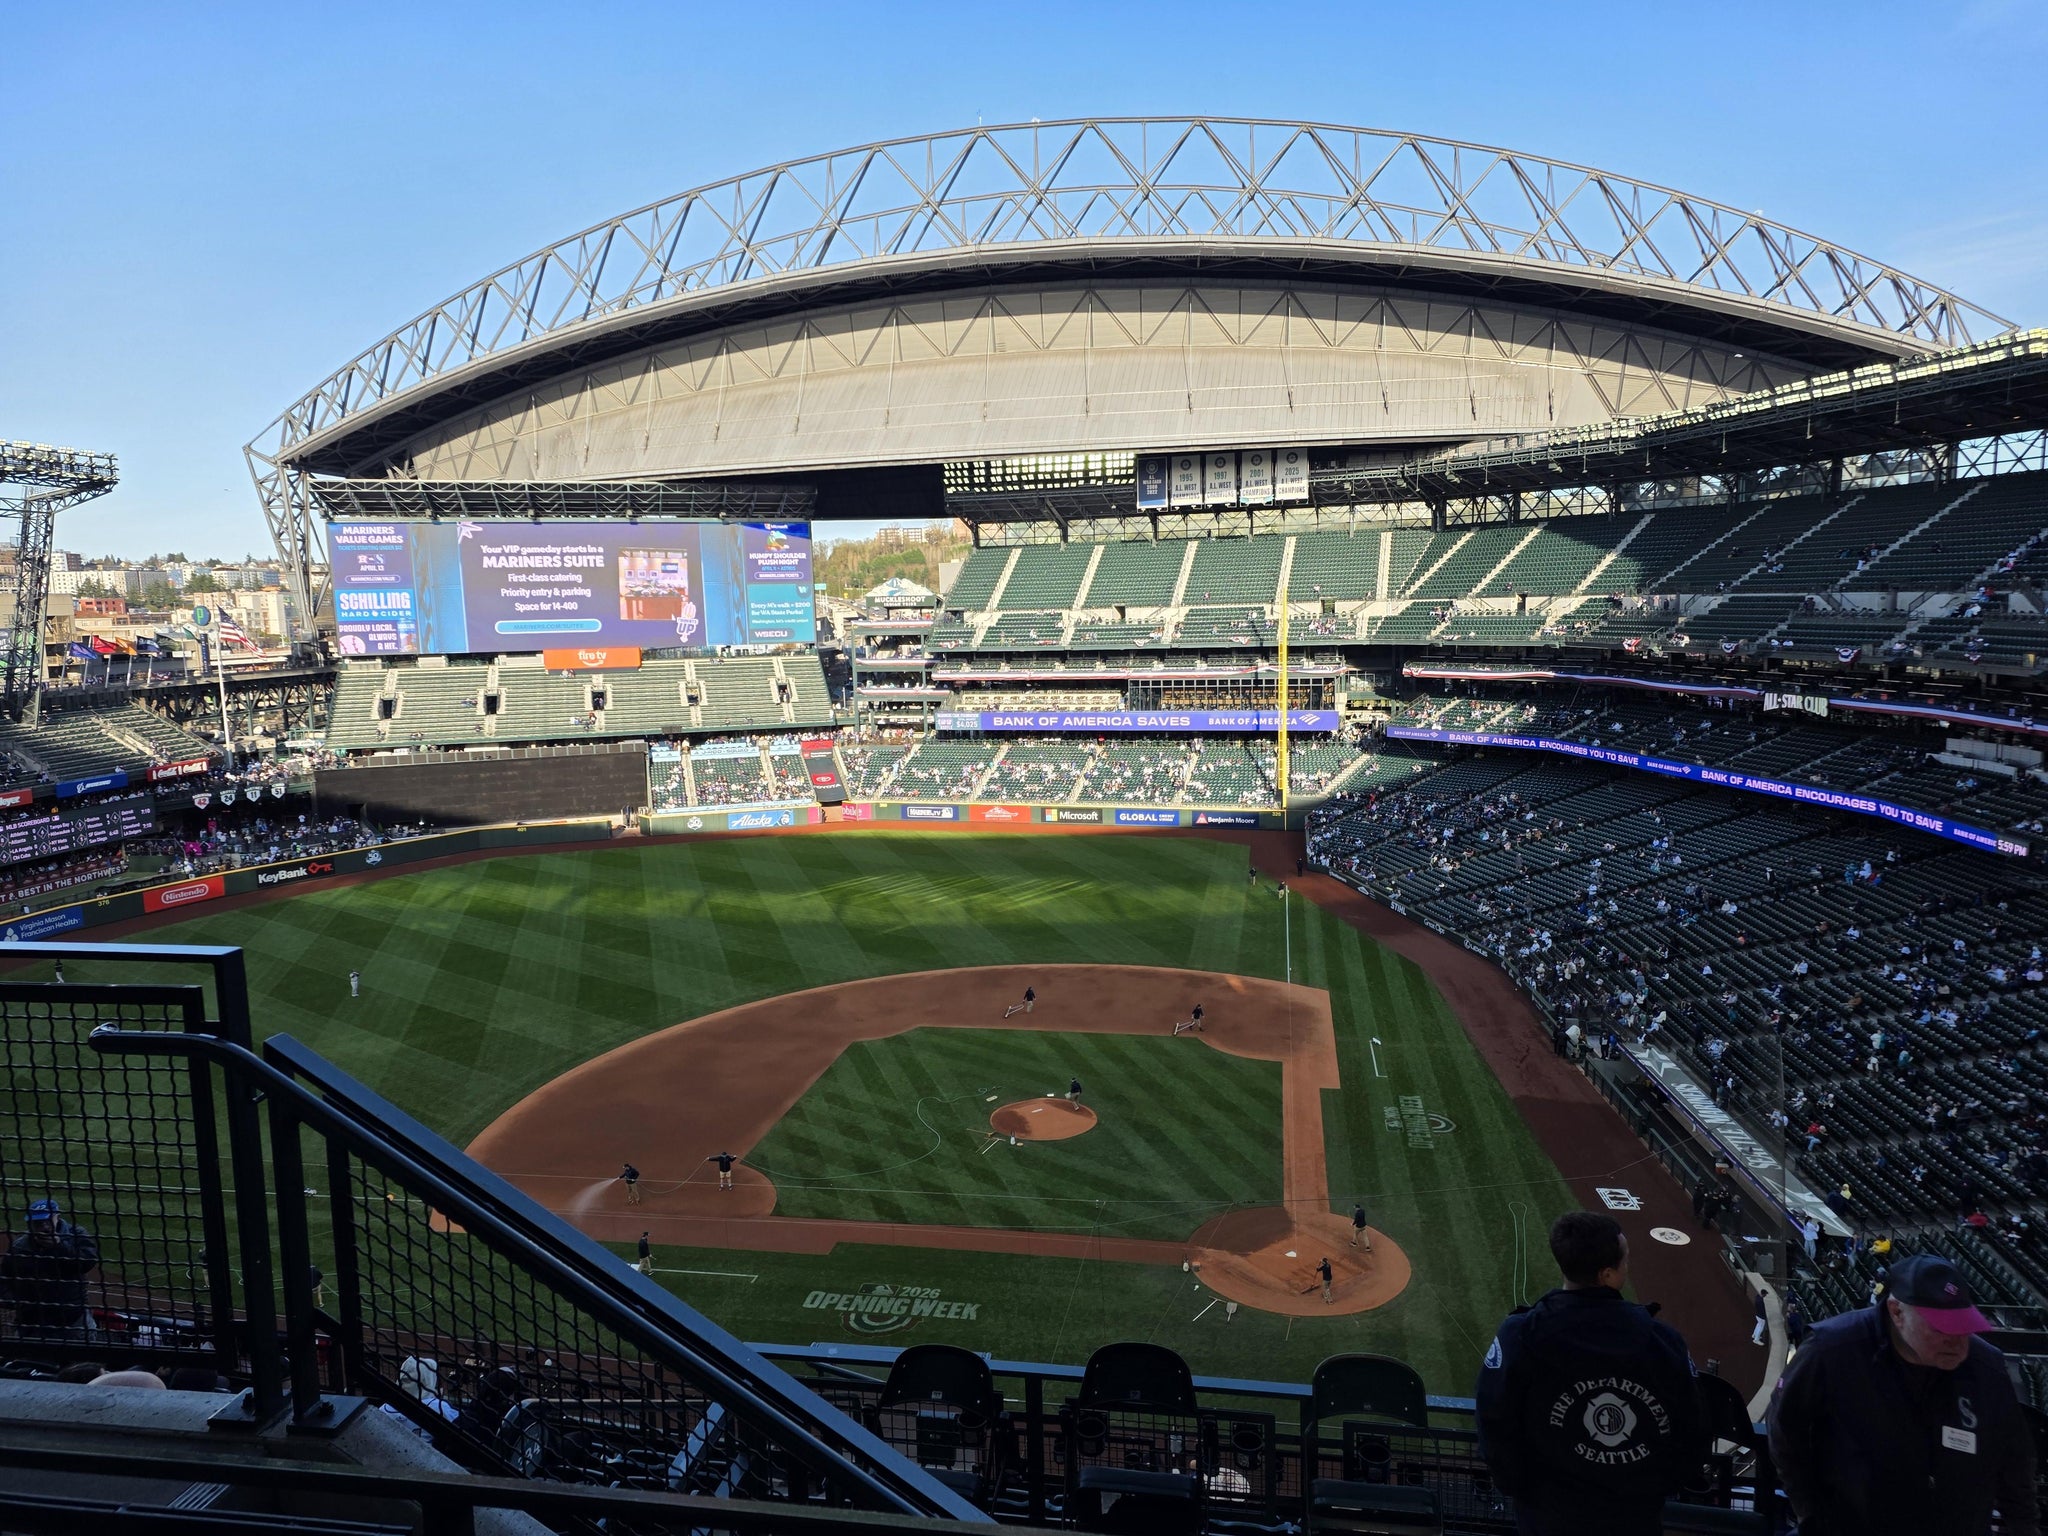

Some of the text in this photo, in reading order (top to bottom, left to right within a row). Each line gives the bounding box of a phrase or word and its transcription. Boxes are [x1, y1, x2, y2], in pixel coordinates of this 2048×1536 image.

[335, 535, 403, 544] VALUE GAMES
[480, 545, 502, 554] Your
[502, 545, 520, 553] VIP
[520, 545, 561, 555] gameday
[483, 555, 605, 568] MARINERS SUITE
[508, 572, 582, 583] First-class catering
[501, 587, 591, 598] Priority entry & parking
[515, 602, 578, 612] Space for 14-400
[578, 651, 607, 660] fire tv
[1804, 696, 1828, 717] CLUB
[993, 717, 1190, 726] BANK OF AMERICA SAVES
[1449, 734, 1474, 742] BANK
[1492, 737, 1536, 747] AMERICA
[1539, 741, 1588, 755] ENCOURAGES
[1589, 749, 1604, 759] YOU
[1606, 752, 1617, 761] TO
[1618, 754, 1638, 766] SAVE
[1701, 770, 1944, 832] BANK OF AMERICA ENCOURAGES YOU TO SAVE
[18, 817, 50, 828] SCOREBOARD
[731, 814, 772, 827] Alaska
[1060, 811, 1098, 820] Microsoft
[1119, 813, 1157, 822] GLOBAL
[1998, 840, 2028, 856] 5:59 PM
[258, 867, 308, 884] KeyBank
[18, 886, 41, 898] BEST
[43, 883, 53, 892] IN
[55, 878, 72, 889] THE
[165, 887, 205, 901] Nintendo
[1391, 902, 1407, 916] STIHL
[20, 914, 66, 931] Virginia Mason
[21, 918, 78, 938] Franciscan Health
[899, 1286, 941, 1299] 2026
[802, 1291, 982, 1320] OPENING WEEK
[1551, 1392, 1575, 1428] FIRE
[1574, 1377, 1671, 1435] DEPARTMENT
[1574, 1443, 1650, 1464] SEATTLE
